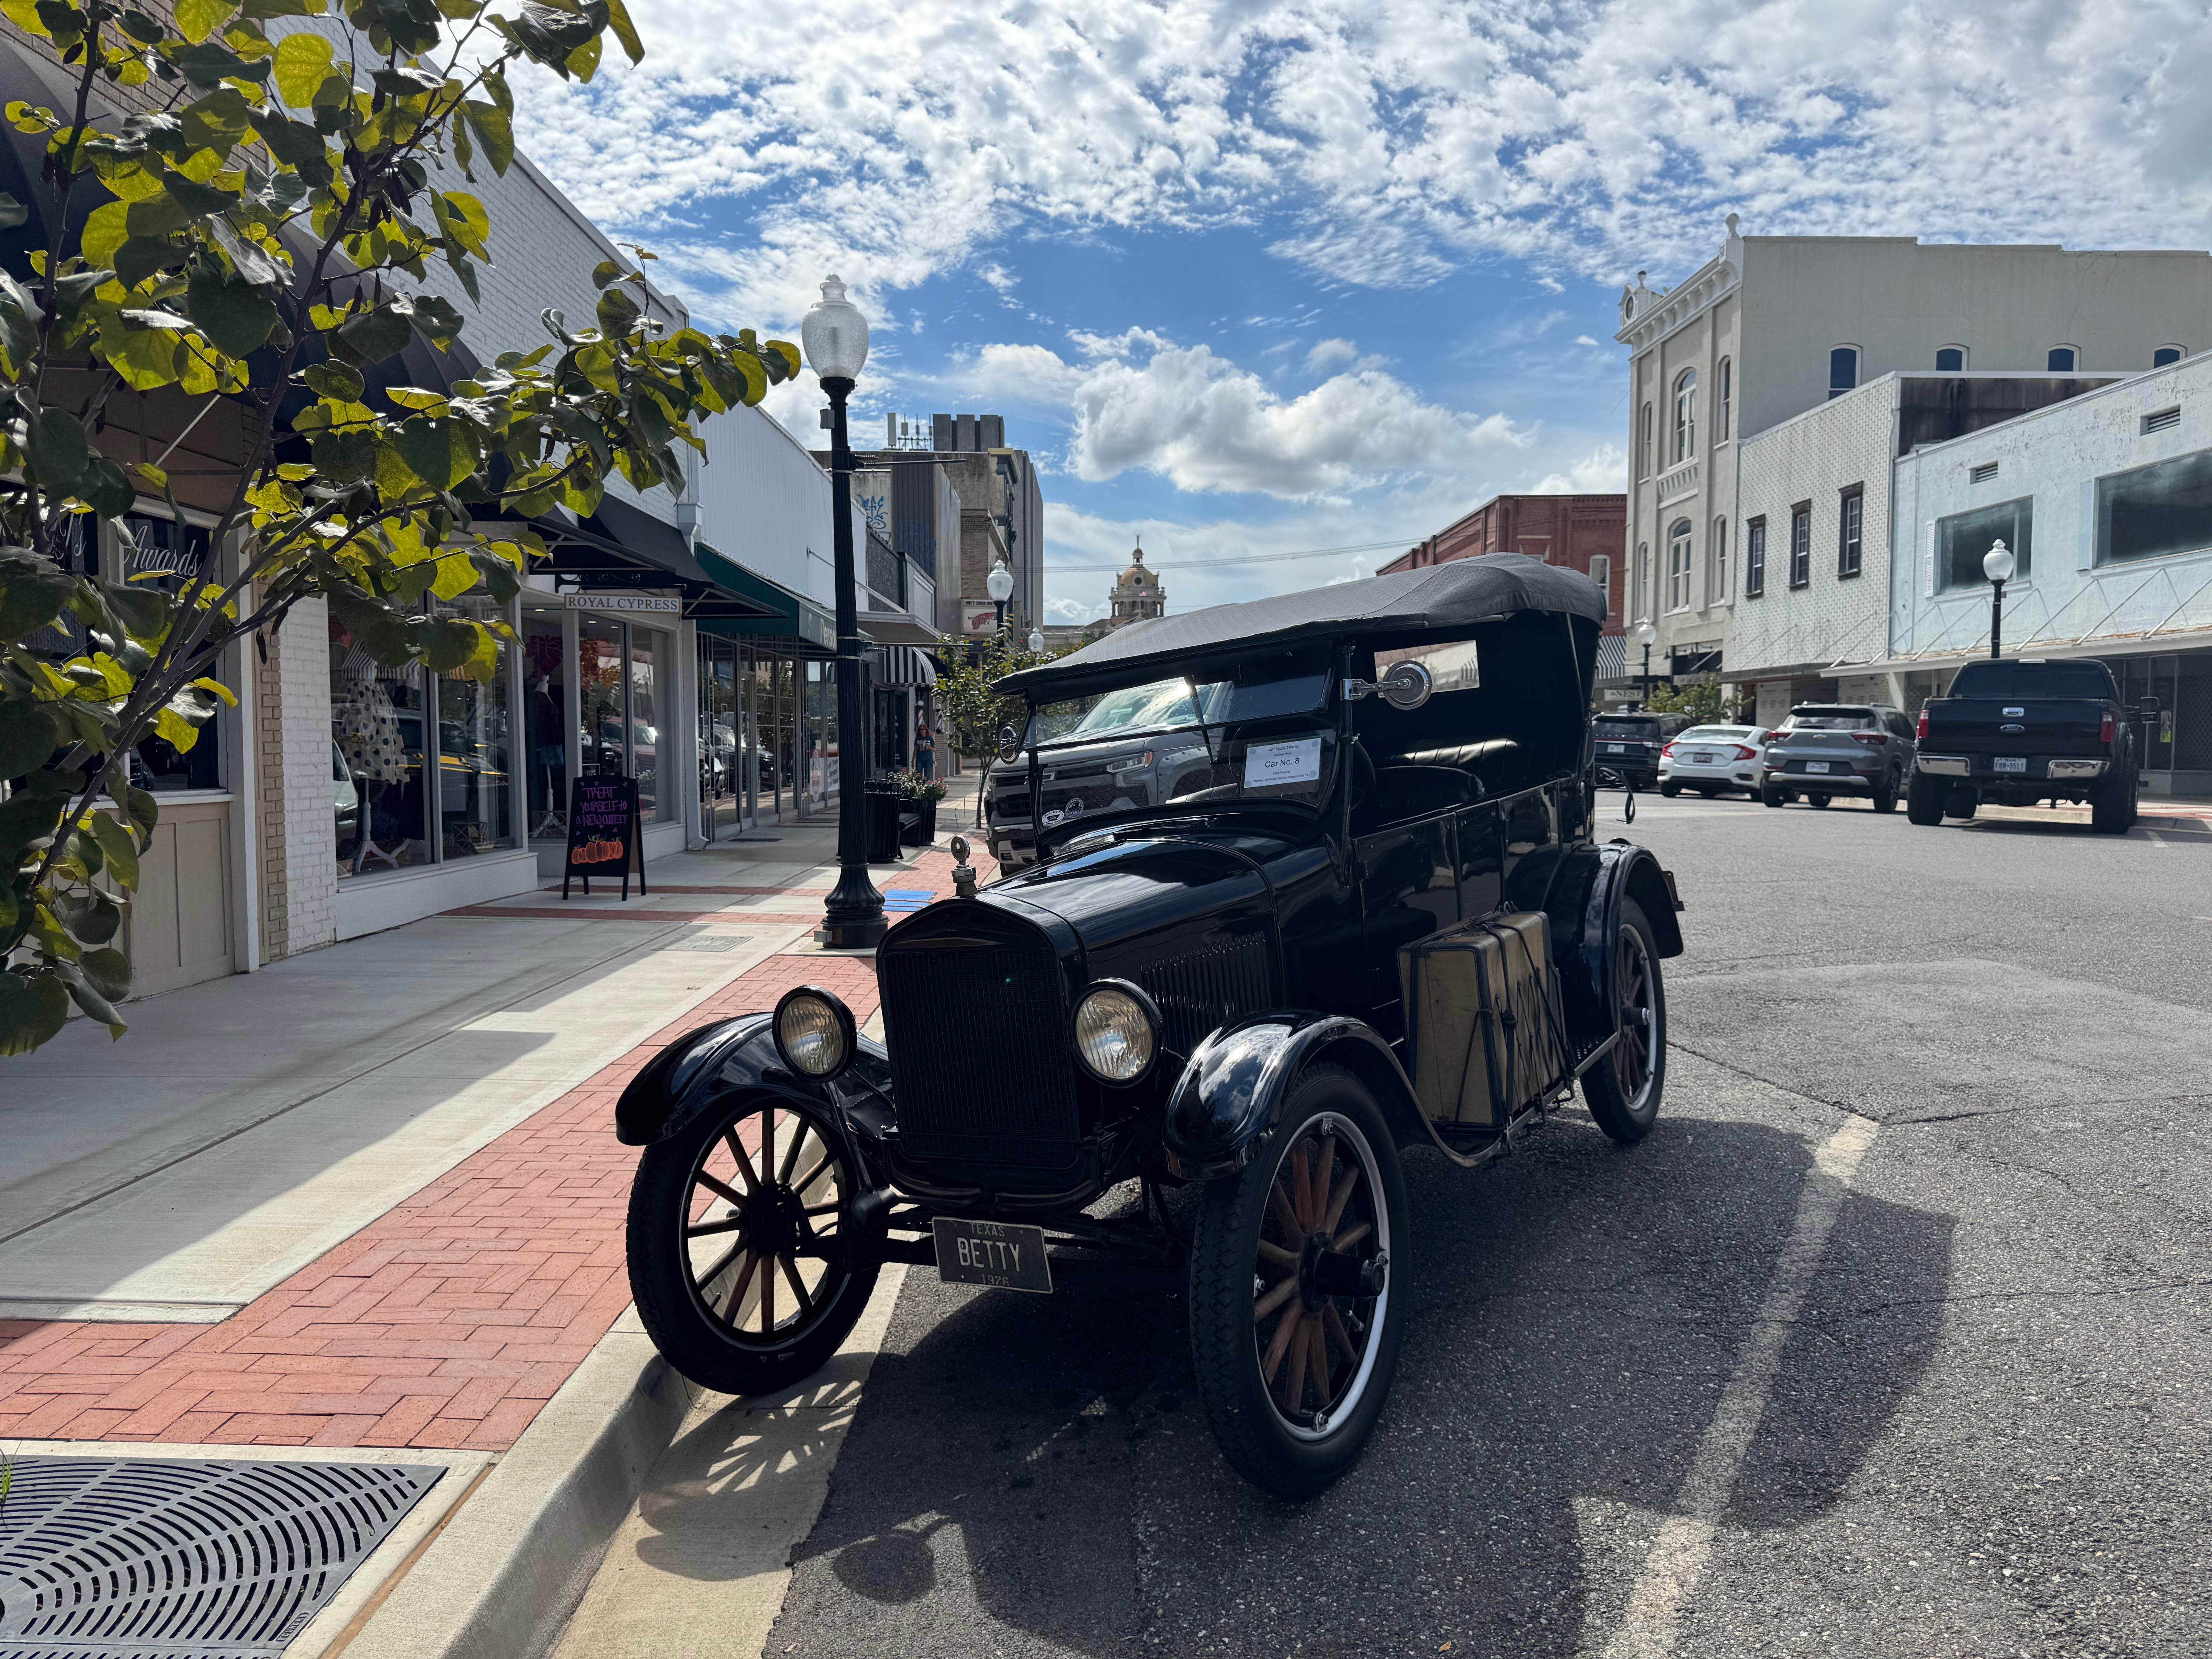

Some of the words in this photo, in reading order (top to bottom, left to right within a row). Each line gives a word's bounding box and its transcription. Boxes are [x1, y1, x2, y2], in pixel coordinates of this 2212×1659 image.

[124, 524, 202, 577] Awards
[568, 597, 614, 608] ROYAL
[618, 598, 678, 610] CYPRESS
[820, 618, 836, 649] Perso
[582, 786, 618, 799] TREAT
[580, 800, 618, 814] YOURSELF
[582, 814, 602, 826] NEW
[970, 1223, 1005, 1237] TEXAS
[957, 1237, 1020, 1272] BETTY
